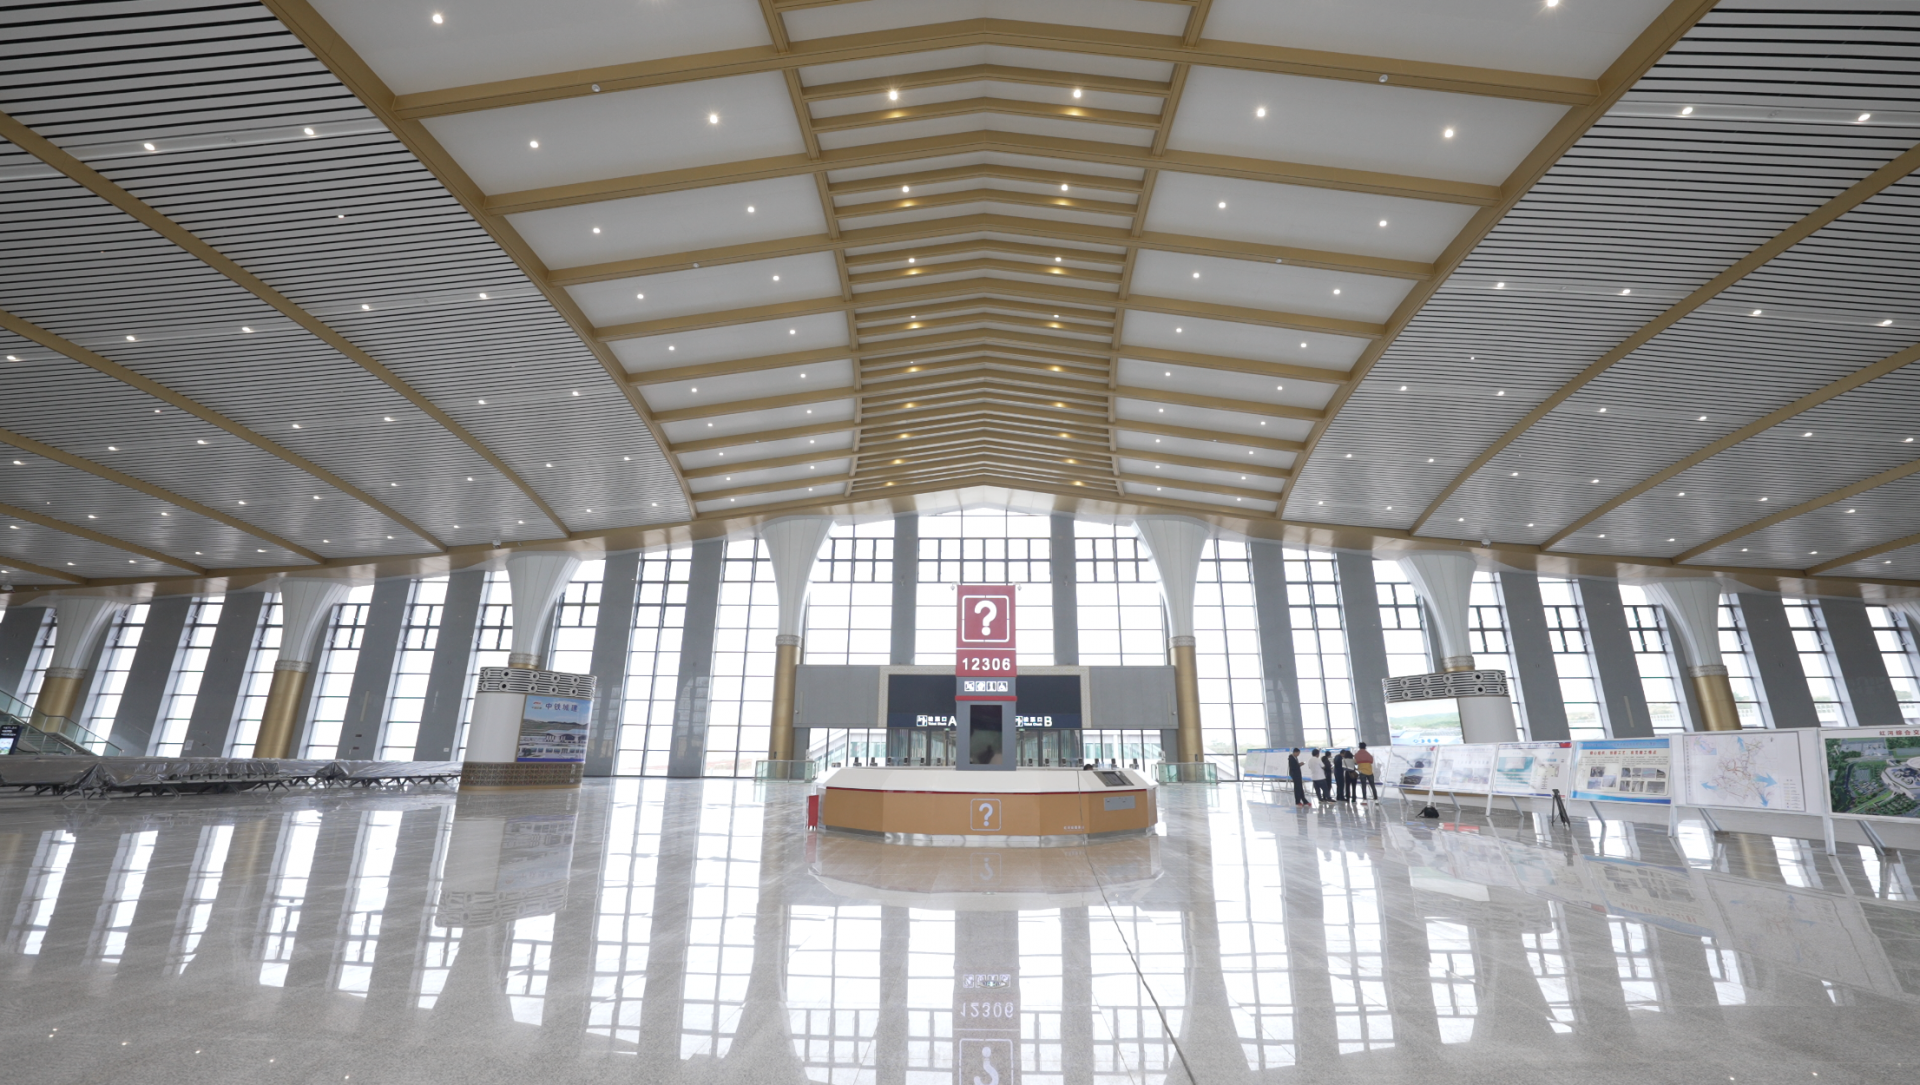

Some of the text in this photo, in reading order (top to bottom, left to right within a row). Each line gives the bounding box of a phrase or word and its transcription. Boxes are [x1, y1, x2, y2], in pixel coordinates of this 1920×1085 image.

[962, 657, 1011, 671] 12306
[545, 702, 578, 712] 中铁城建
[947, 715, 957, 727] A
[1044, 715, 1053, 727] B
